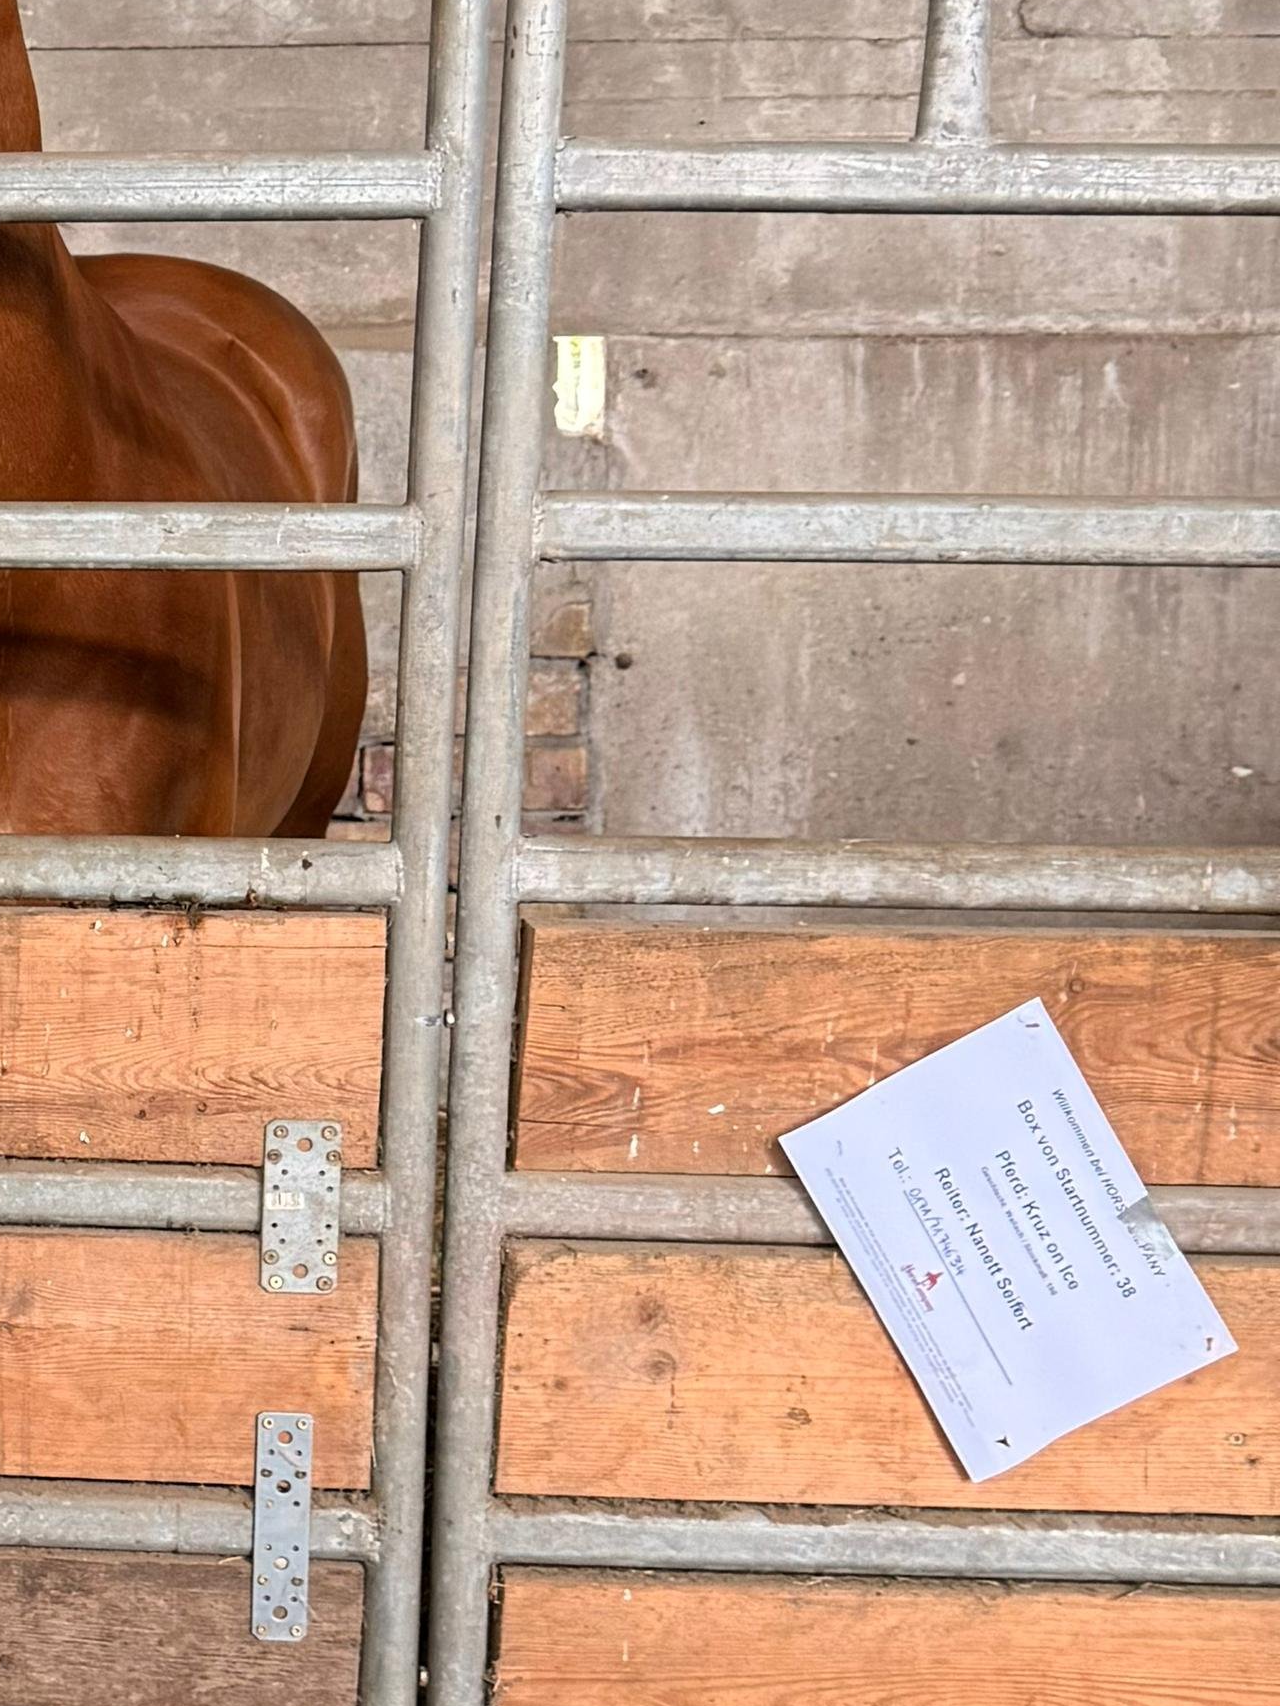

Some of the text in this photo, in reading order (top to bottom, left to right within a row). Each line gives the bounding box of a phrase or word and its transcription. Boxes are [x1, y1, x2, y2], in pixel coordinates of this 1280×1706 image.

[885, 1147, 914, 1184] Tel.:
[1016, 1098, 1136, 1299] Box von Startnummer: 38
[1050, 1087, 1097, 1159] Willkommen
[1089, 1156, 1107, 1177] bei
[933, 1166, 1035, 1331] Reiter: Nanett Seifert
[993, 1149, 1082, 1292] Pferd: Kruz on Ice
